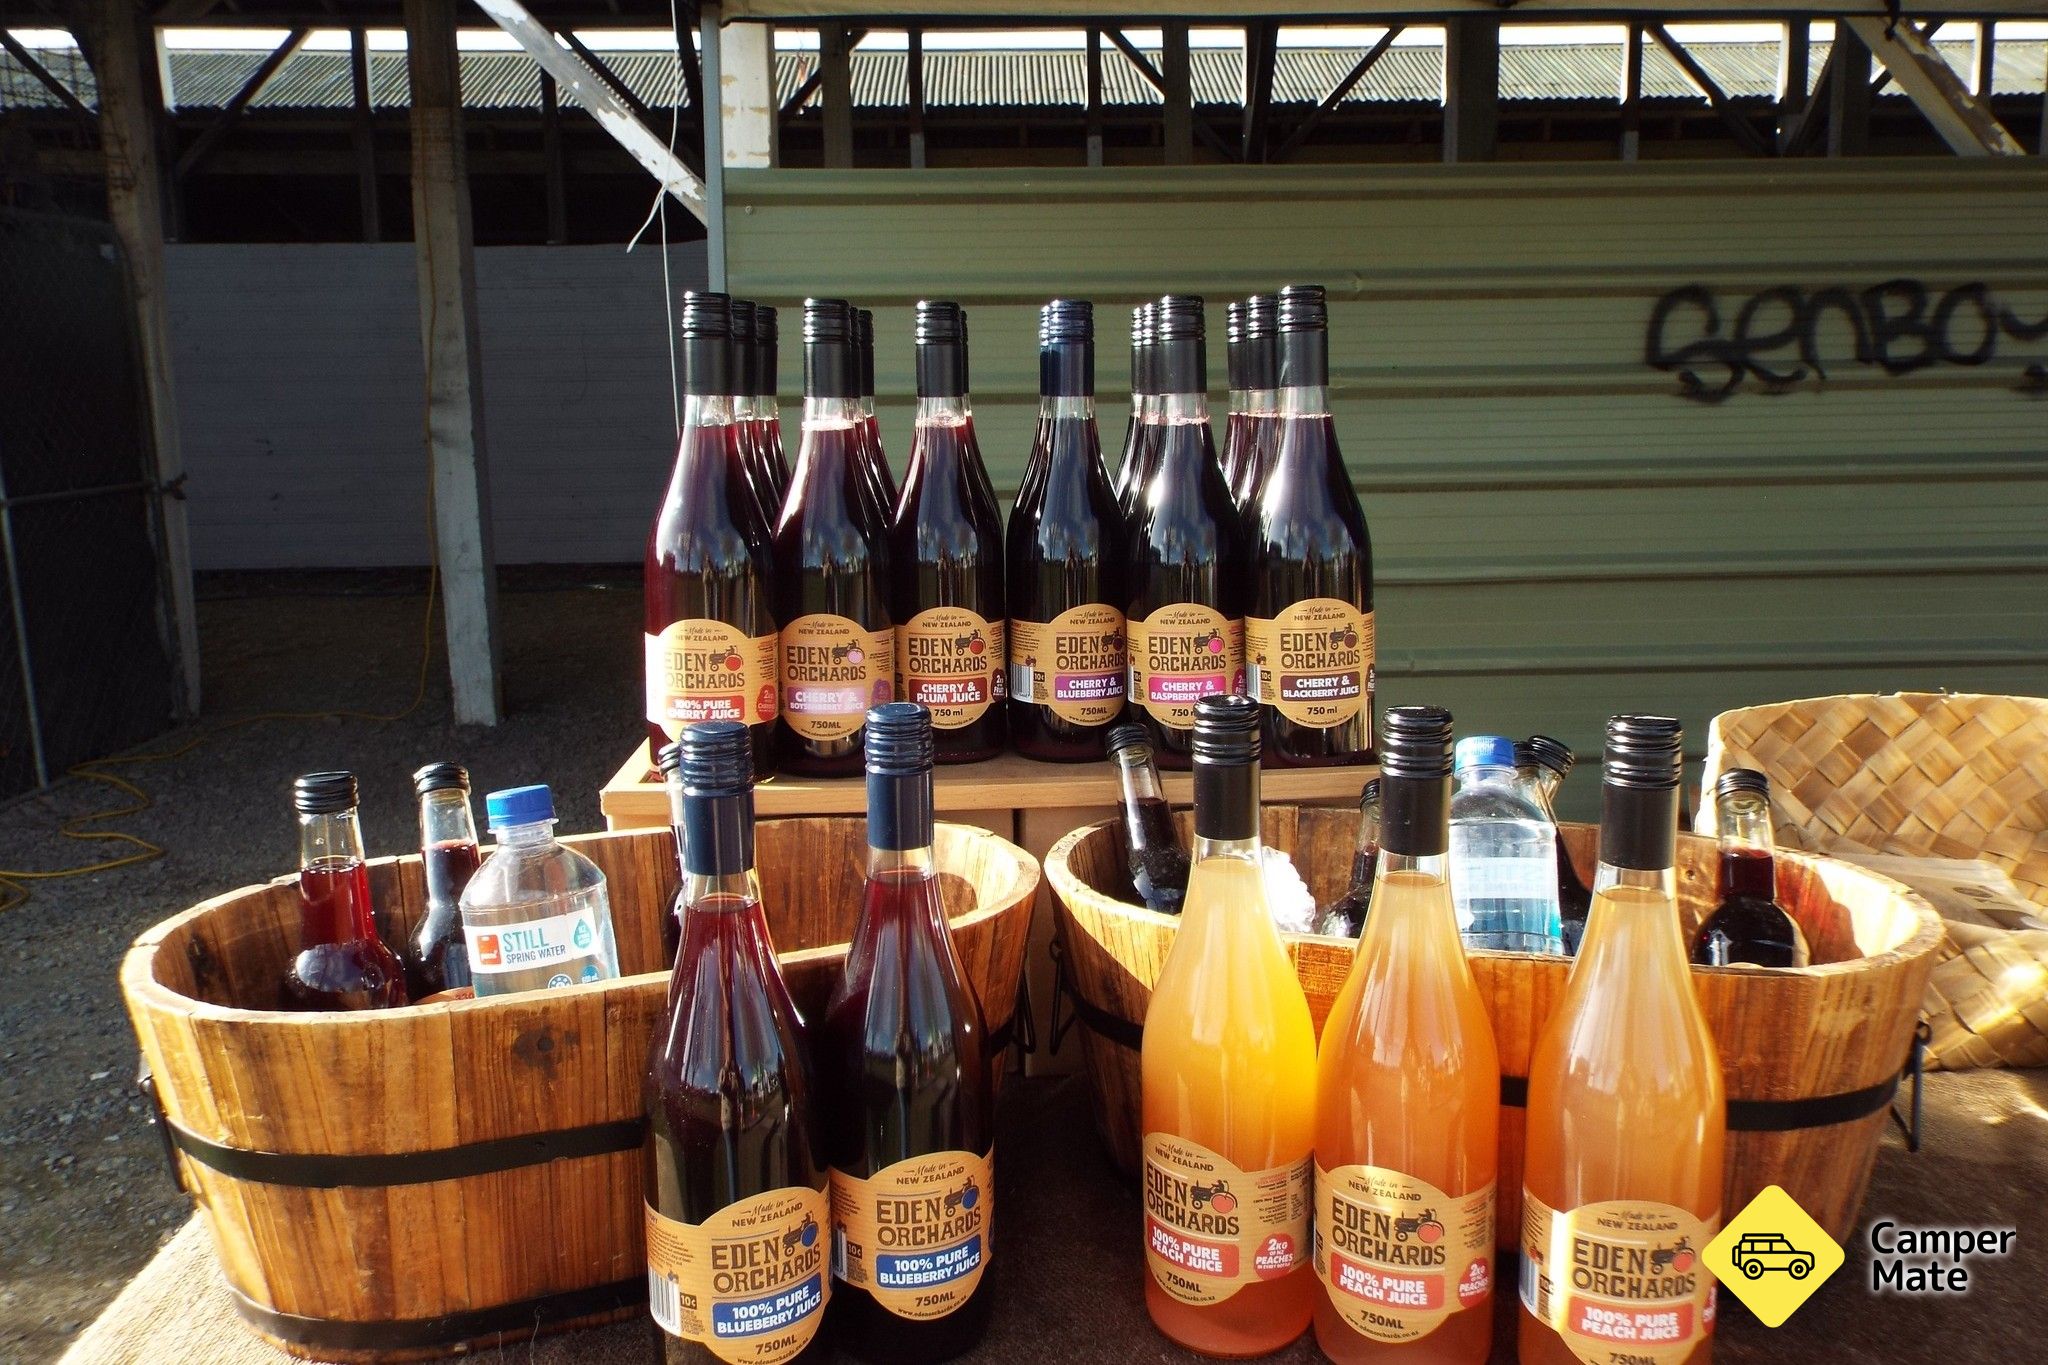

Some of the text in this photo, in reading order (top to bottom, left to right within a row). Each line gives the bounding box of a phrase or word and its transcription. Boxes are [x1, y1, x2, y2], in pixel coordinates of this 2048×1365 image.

[908, 637, 952, 656] EDEN
[1056, 636, 1099, 654] EDEN
[1149, 637, 1191, 654] EDEN
[1281, 633, 1327, 651] EDEN
[665, 652, 706, 672] EDEN
[787, 646, 829, 664] EDEN
[1057, 654, 1125, 670] ORCHARDS
[1149, 655, 1226, 671] ORCHARDS
[1281, 650, 1360, 668] ORCHARDS
[788, 666, 866, 681] ORCHARDS
[910, 656, 987, 673] ORCHARDS
[665, 672, 745, 689] ORCHARDS
[922, 683, 976, 693] CHERRY &
[1069, 679, 1107, 689] CHERRY
[1162, 681, 1214, 691] CHERRY &
[1296, 676, 1350, 688] CHERRY &
[796, 691, 843, 702] CHERRY
[847, 691, 857, 702] &
[917, 692, 980, 702] PLUM JUICE
[1057, 688, 1106, 698] BLUEBERRY
[1106, 686, 1123, 696] JUICE
[1151, 691, 1200, 701] RASPBERRY
[1283, 689, 1338, 698] BLACKBERRY
[1339, 686, 1359, 696] JUICE
[674, 699, 731, 710] 100% PURE
[1081, 707, 1107, 715] 750ML
[1172, 708, 1189, 716] 750
[1308, 706, 1337, 715] 750 ml
[710, 709, 741, 719] JUICE
[811, 721, 841, 729] 750ML
[503, 928, 549, 952] STILL
[507, 951, 536, 964] SPRING
[538, 945, 566, 959] WATER
[1155, 1147, 1214, 1172] NEW ZEALAND
[896, 1166, 964, 1185] NEW ZEALAND
[915, 1163, 946, 1176] Made in
[1146, 1162, 1187, 1207] EDEN
[1349, 1180, 1422, 1201] NEW ZEALAND
[732, 1202, 802, 1227] NEW ZEALAND
[751, 1200, 783, 1216] Made in
[877, 1197, 941, 1224] EDEN
[1147, 1190, 1239, 1235] ORCHARDS
[878, 1206, 981, 1246] ORCHARDS
[1332, 1197, 1391, 1240] EDEN
[1597, 1218, 1678, 1231] NEW ZEALAND
[711, 1236, 780, 1270] EDEN
[1153, 1227, 1220, 1261] 100% PURE
[1268, 1239, 1288, 1251] 2KG
[1332, 1224, 1445, 1266] ORCHARDS
[895, 1246, 969, 1272] 100% PURE
[1152, 1238, 1222, 1272] PEACH JUICE
[1256, 1254, 1293, 1264] PEACHES
[1573, 1237, 1647, 1275] EDEN
[713, 1243, 820, 1293] ORCHARDS
[880, 1268, 953, 1284] BLUEBERRY
[954, 1251, 980, 1274] JUICE
[1166, 1271, 1202, 1293] 750ML
[1342, 1263, 1379, 1287] 100%
[1382, 1277, 1425, 1293] PURE
[1573, 1267, 1696, 1299] ORCHARDS
[915, 1290, 955, 1307] 750ML
[1340, 1275, 1428, 1305] PEACH JUICE
[732, 1285, 809, 1320] 100% PURE
[718, 1313, 792, 1334] BLUEBERRY
[795, 1291, 821, 1319] JUICE
[1361, 1310, 1404, 1329] 750ML
[1585, 1306, 1678, 1327] 100% PURE
[1582, 1319, 1680, 1340] PEACH JUICE
[756, 1334, 797, 1355] 750ML
